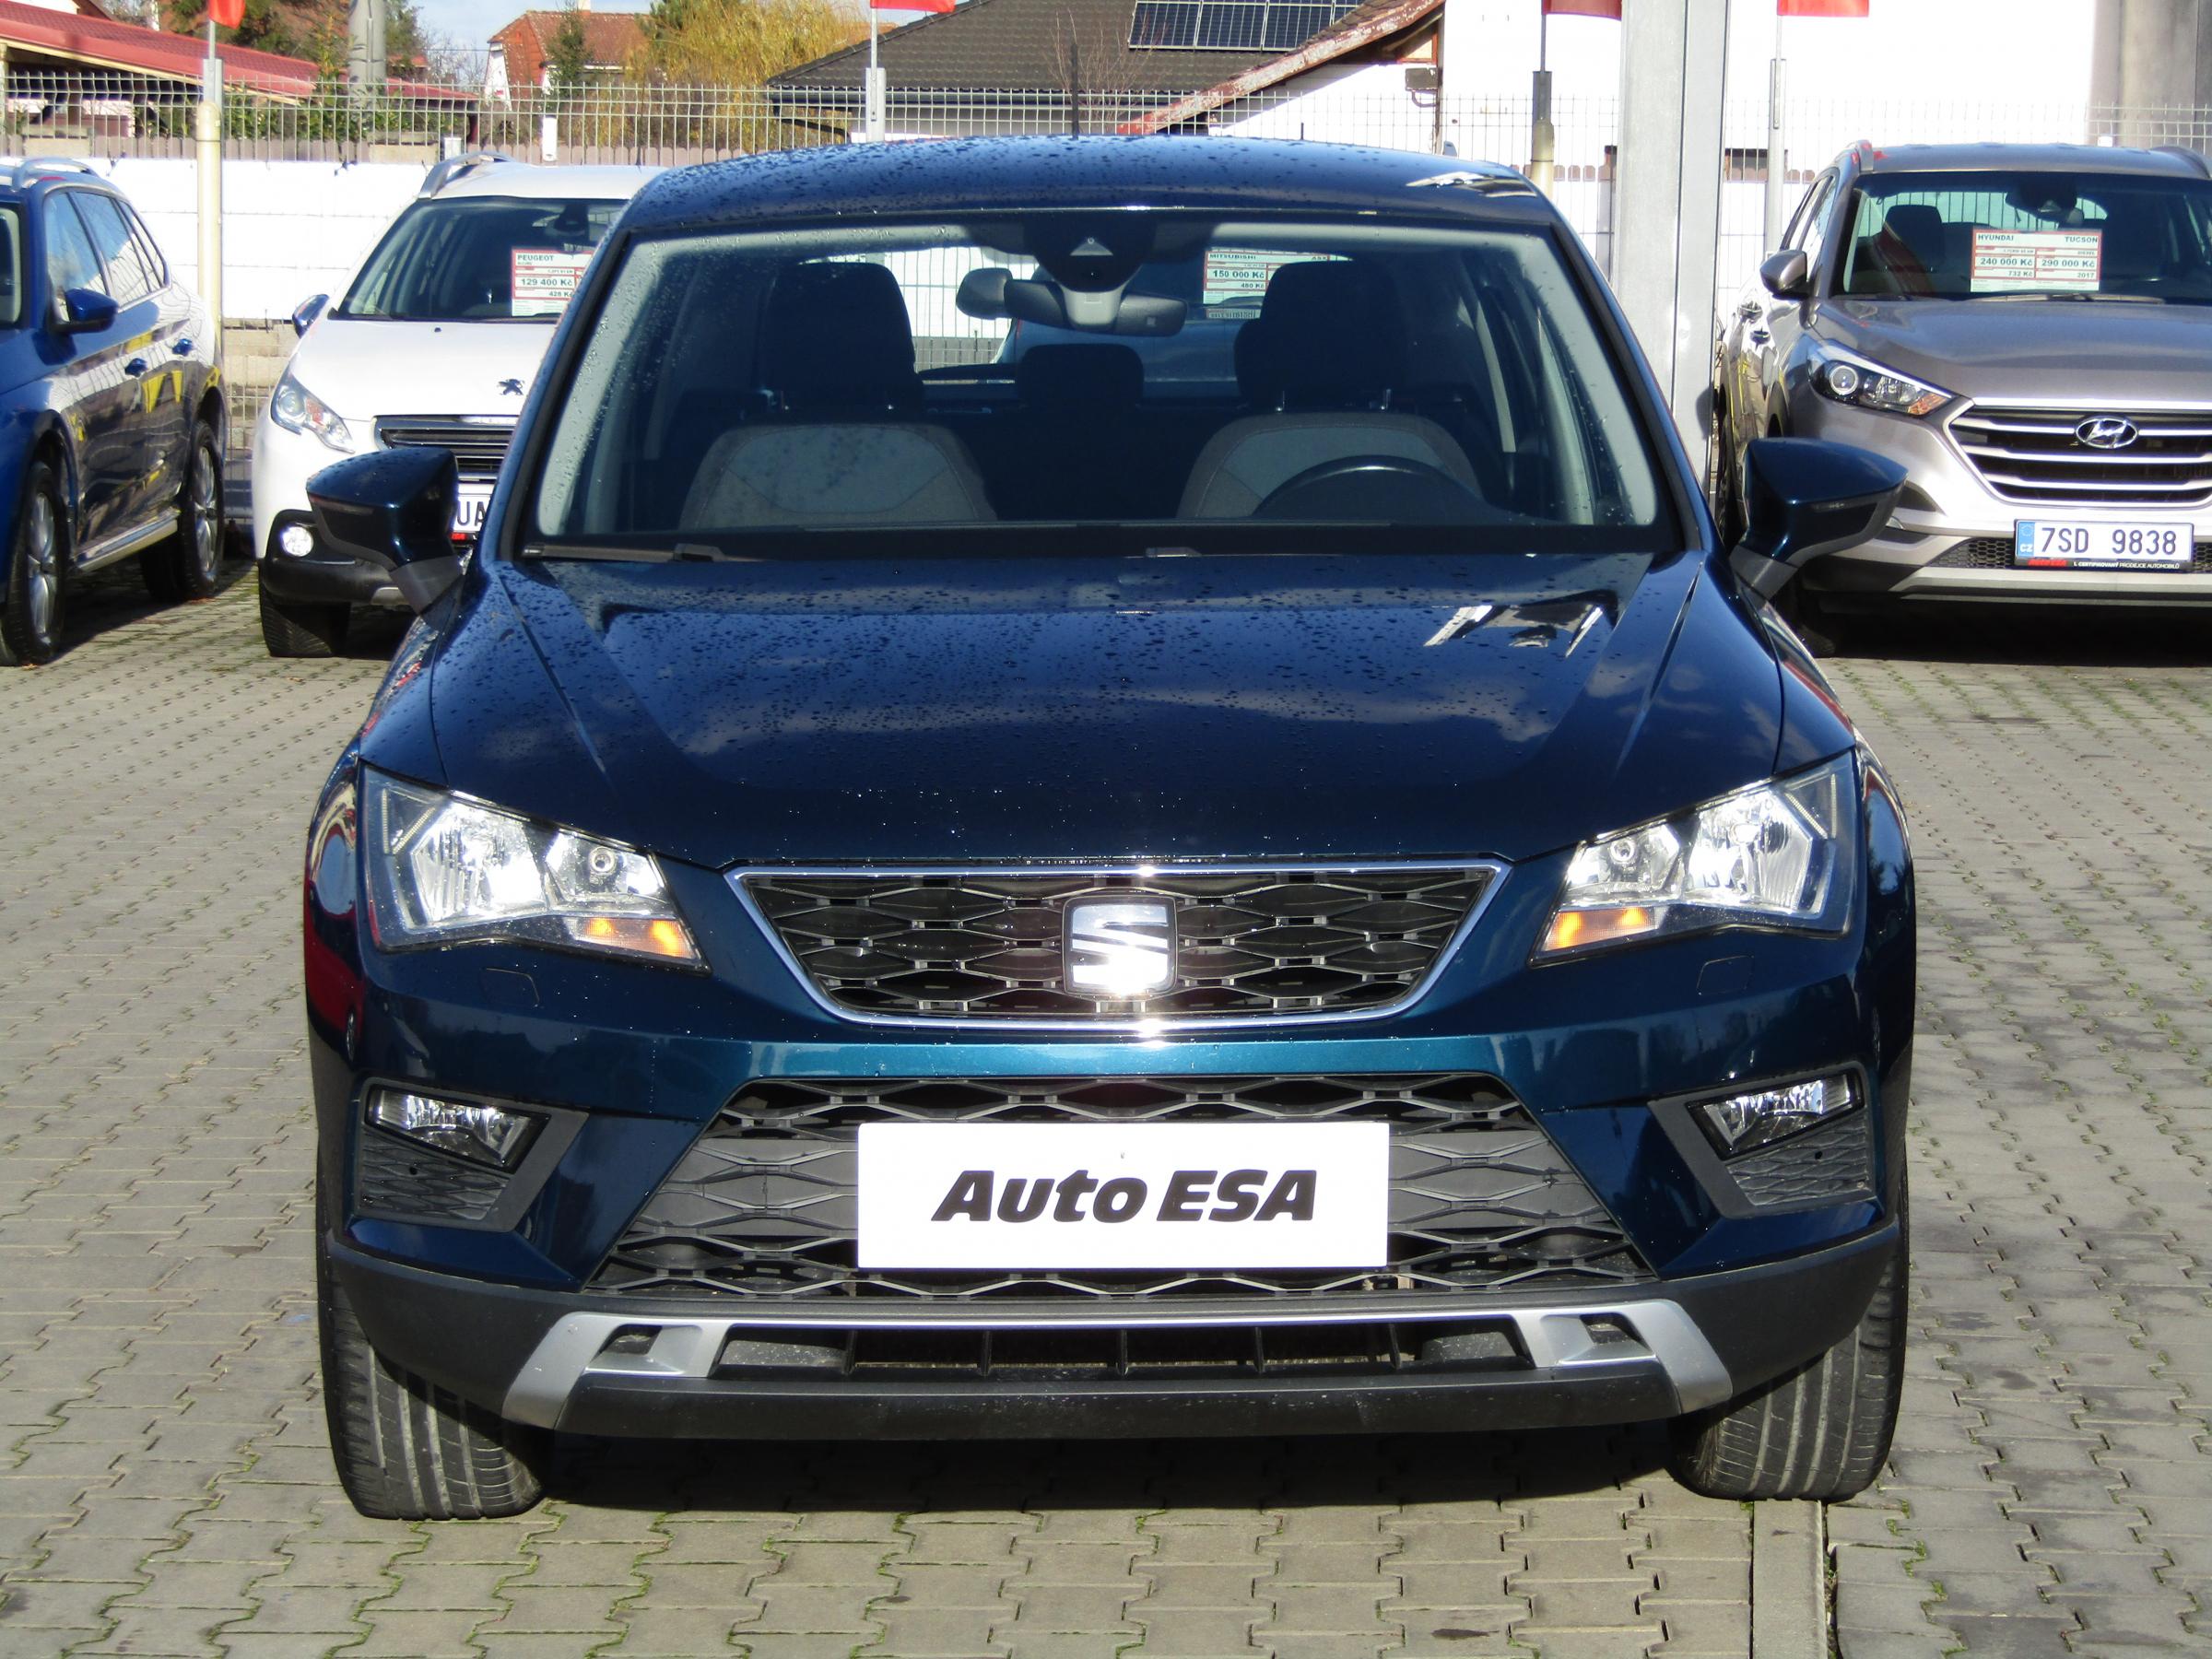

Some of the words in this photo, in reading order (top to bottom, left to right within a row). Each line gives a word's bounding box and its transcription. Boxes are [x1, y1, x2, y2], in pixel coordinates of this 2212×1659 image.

[1980, 257, 1998, 265] 240
[2020, 258, 2033, 266] Kč
[2019, 544, 2033, 552] CZ
[2041, 527, 2089, 553] 7SD
[2112, 529, 2177, 555] 9838
[931, 1170, 1147, 1223] Auto
[1157, 1169, 1317, 1222] ESA
